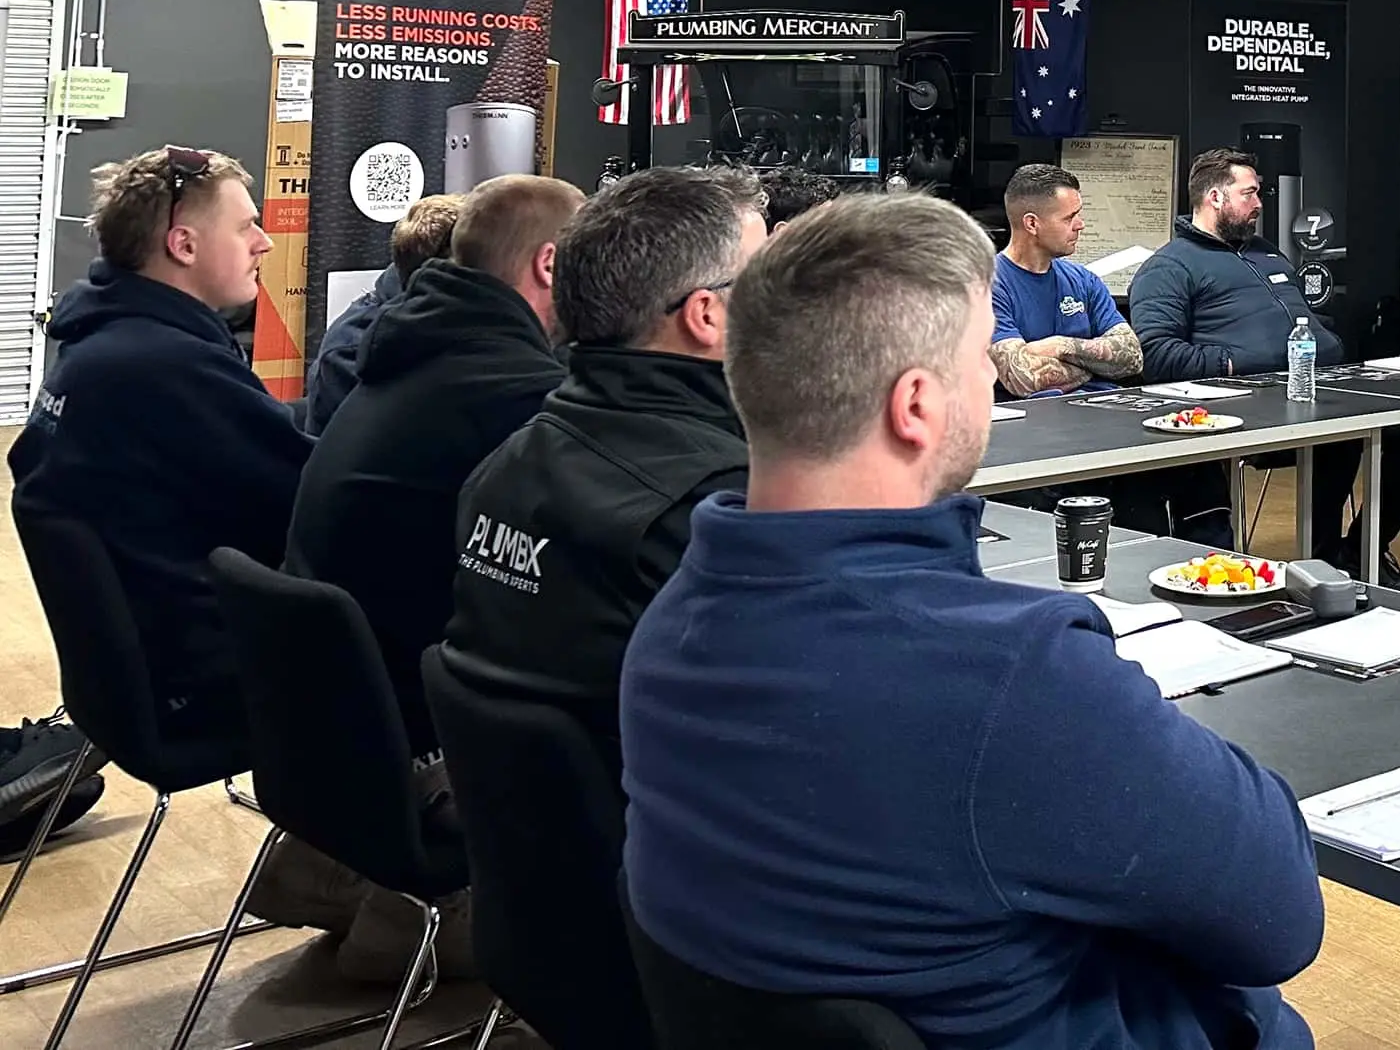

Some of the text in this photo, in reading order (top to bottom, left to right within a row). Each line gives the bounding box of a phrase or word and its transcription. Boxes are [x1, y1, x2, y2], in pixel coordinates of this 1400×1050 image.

[335, 3, 542, 32] LESS RUNNING COSTS.
[657, 17, 876, 37] PLUMBING MERCHANT
[335, 23, 496, 47] LESS EMISSIONS.
[1224, 18, 1315, 41] DURABLE,
[334, 42, 489, 66] MORE REASONS
[1207, 35, 1331, 60] DEPENDABLE,
[334, 62, 450, 83] TO INSTALL.
[1235, 54, 1305, 73] DIGITAL
[1231, 94, 1271, 102] INTEGRATED
[1257, 86, 1297, 94] INNOVATIVE
[279, 178, 311, 194] TH
[1307, 215, 1321, 236] 7
